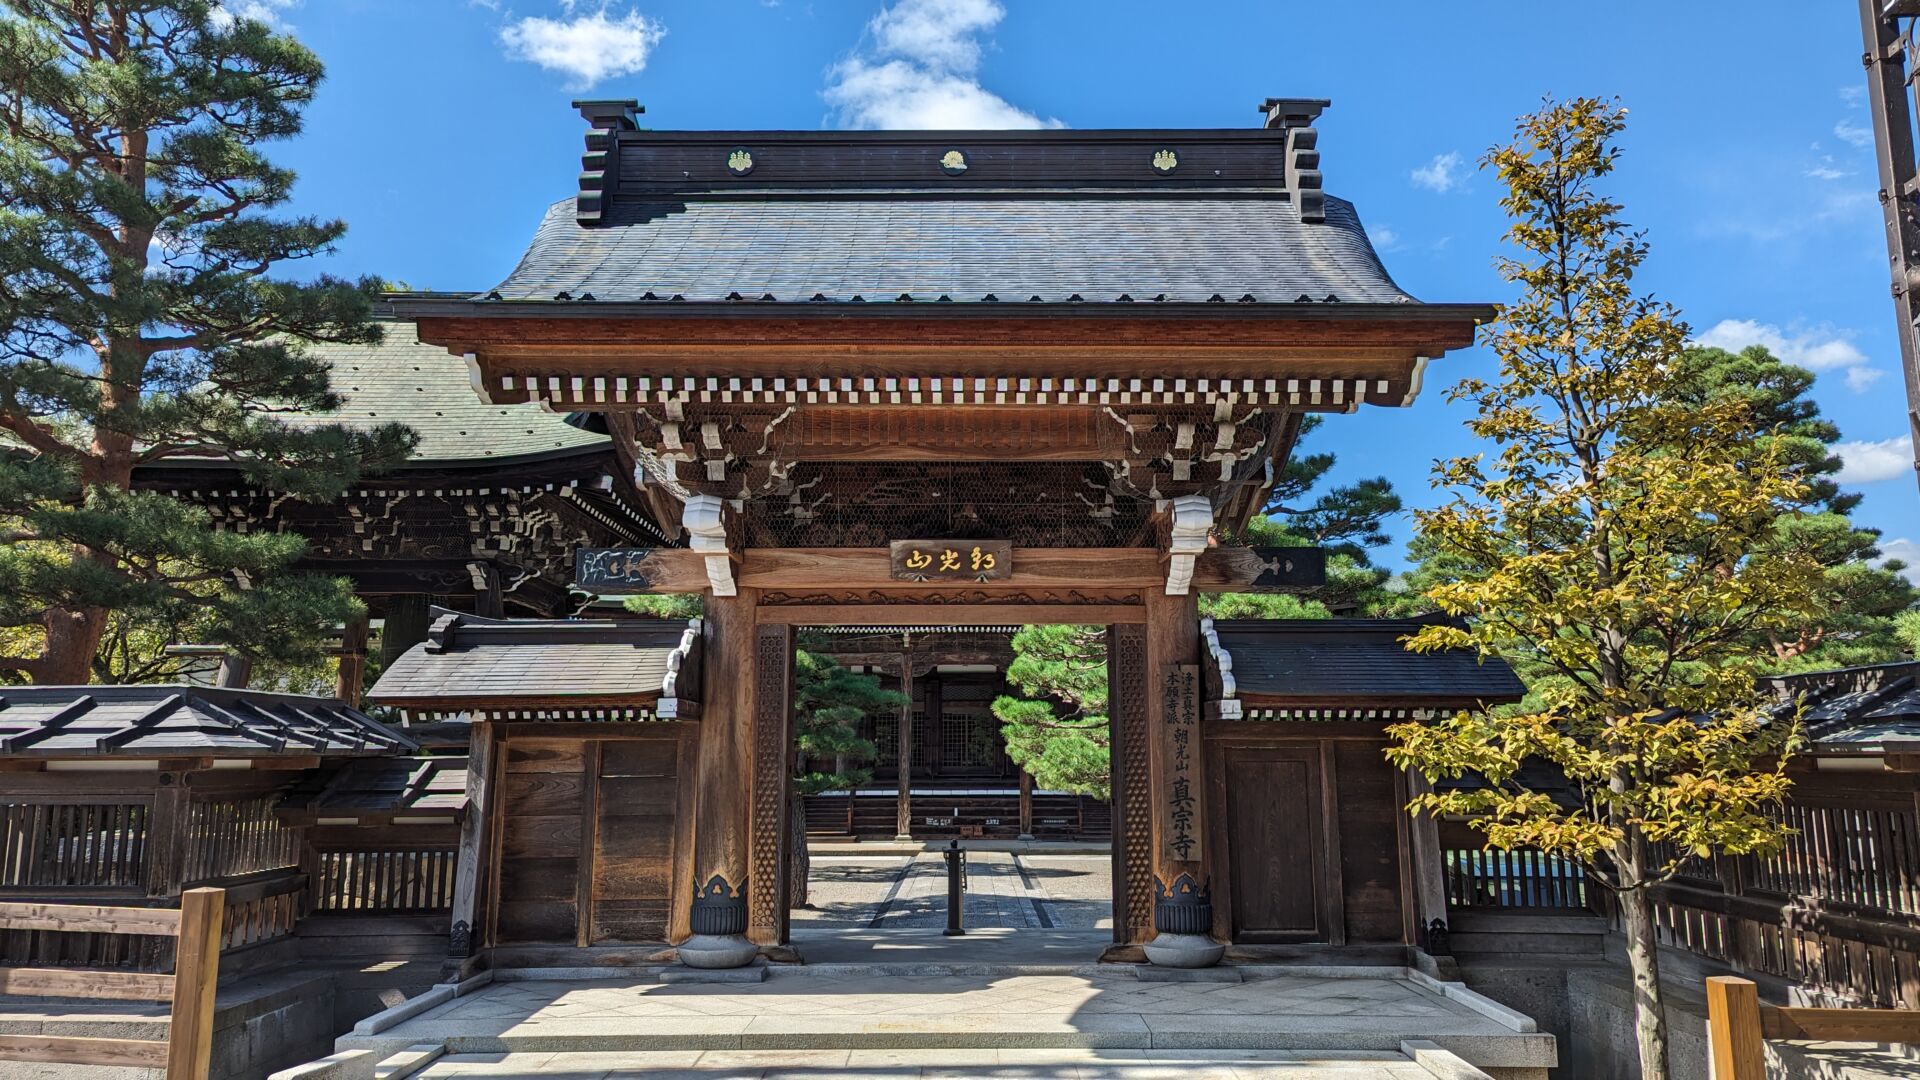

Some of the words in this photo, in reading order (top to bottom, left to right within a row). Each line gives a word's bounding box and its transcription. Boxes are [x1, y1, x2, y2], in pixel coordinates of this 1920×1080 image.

[1174, 727, 1190, 772] 朝光山
[1169, 776, 1197, 860] 真宗寺
